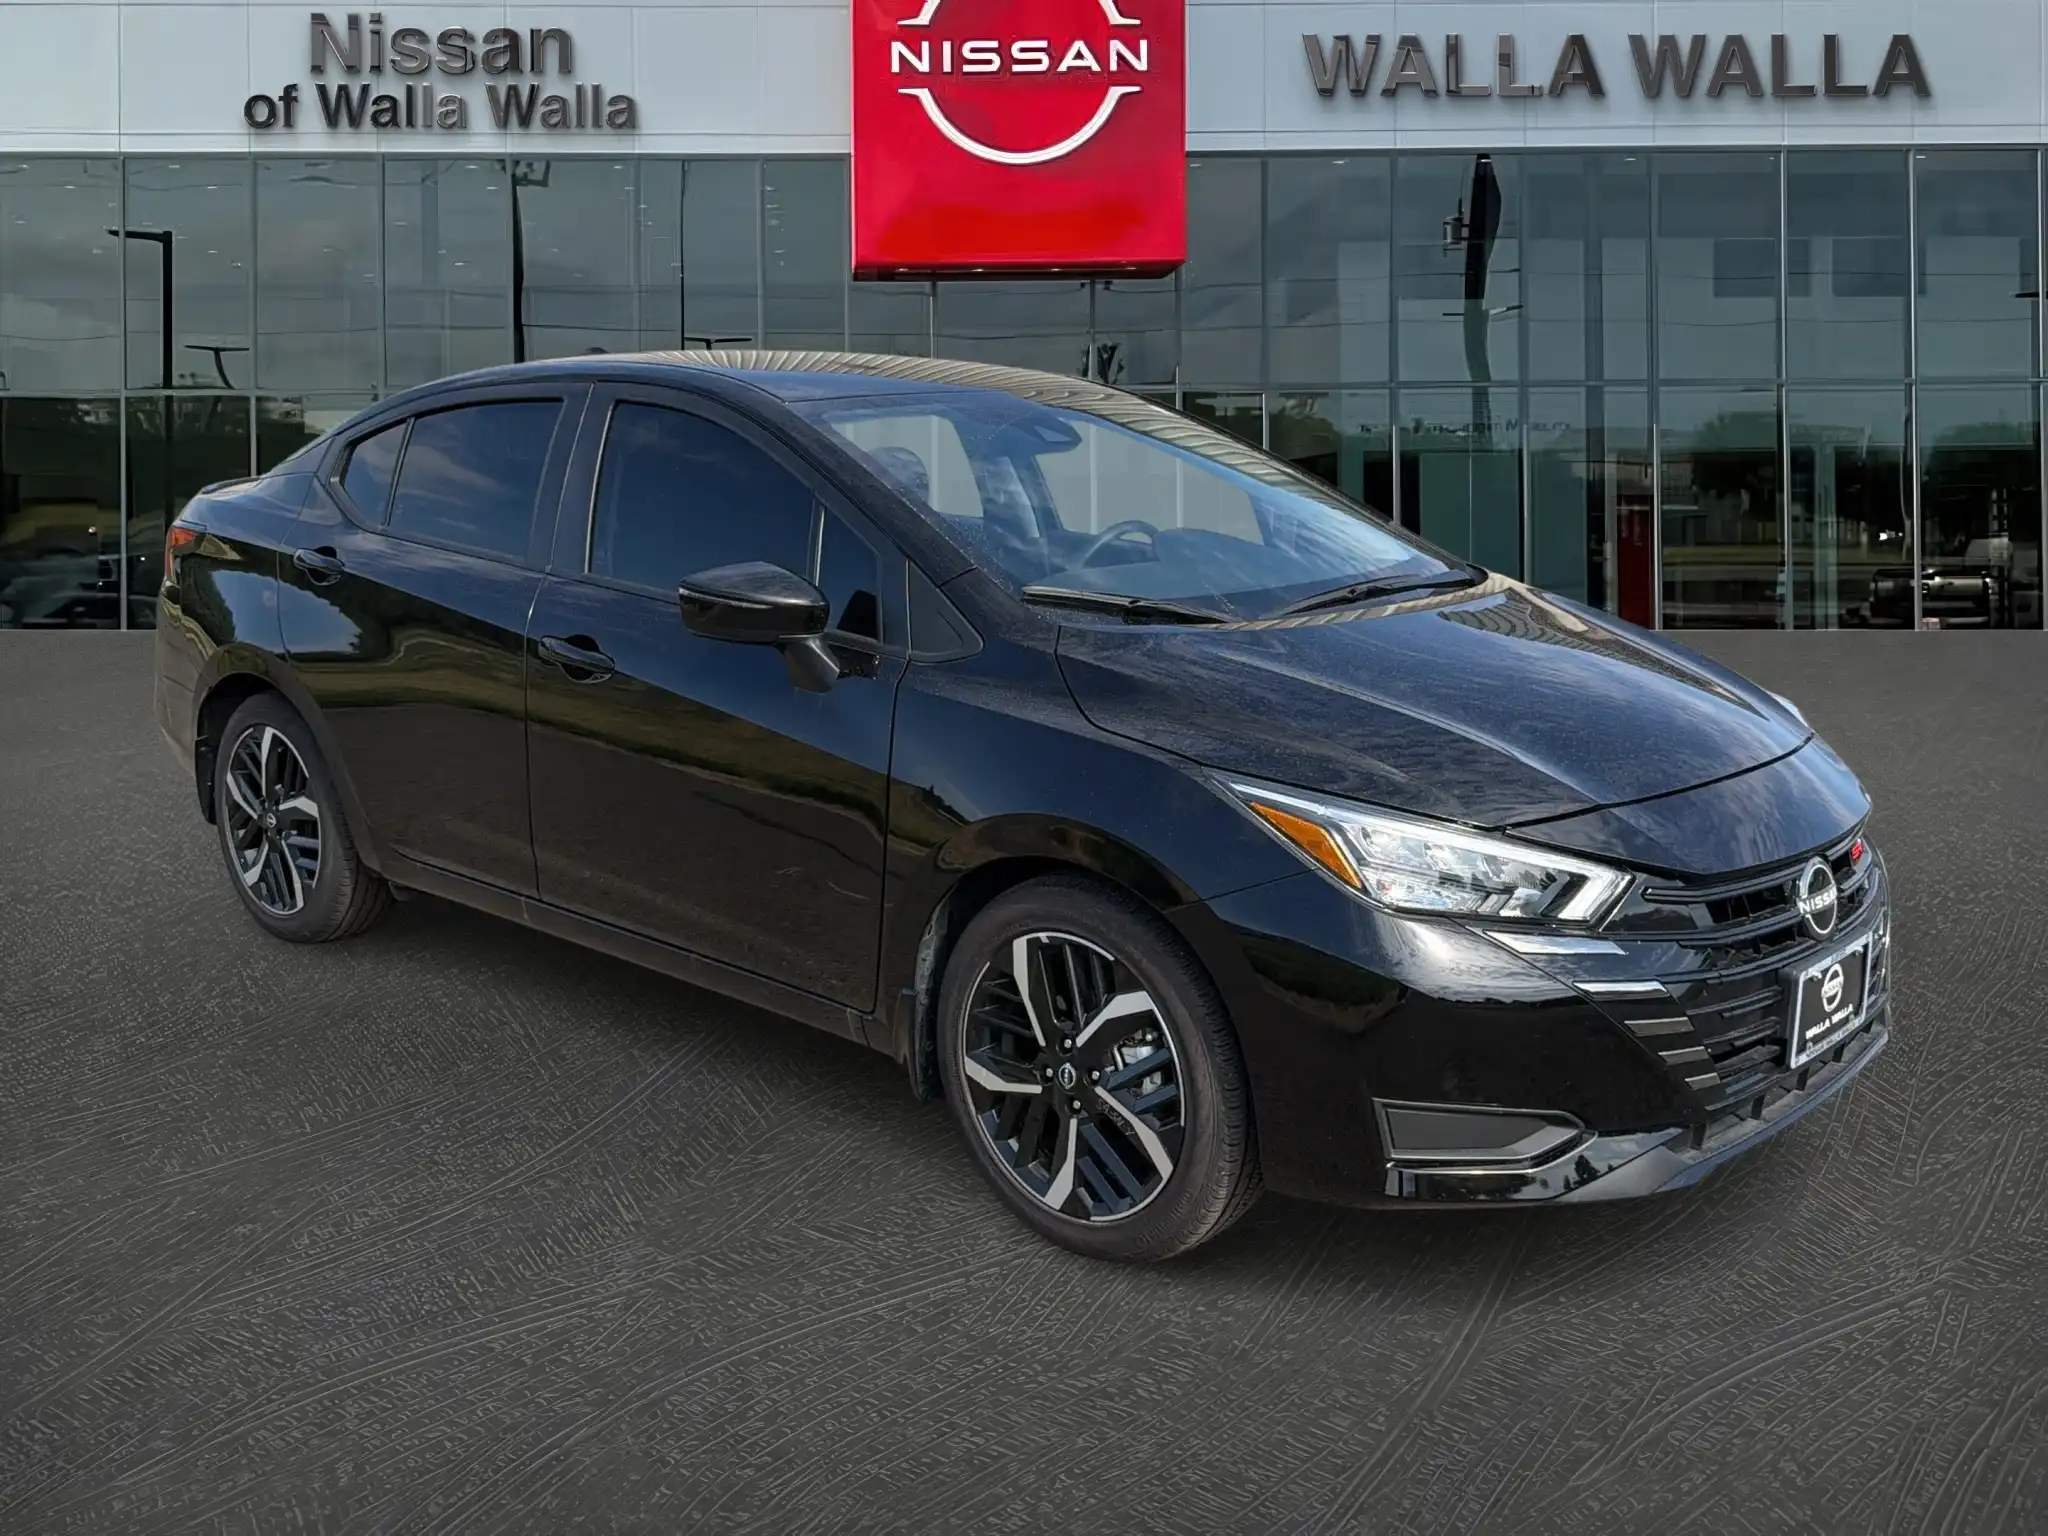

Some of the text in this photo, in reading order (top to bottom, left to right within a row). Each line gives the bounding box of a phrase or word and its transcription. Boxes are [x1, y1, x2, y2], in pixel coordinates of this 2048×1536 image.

[310, 12, 572, 75] Nissan
[890, 39, 1149, 73] NISSAN
[1302, 32, 1932, 98] WALLA WALLA
[243, 82, 637, 129] of Walla Walla
